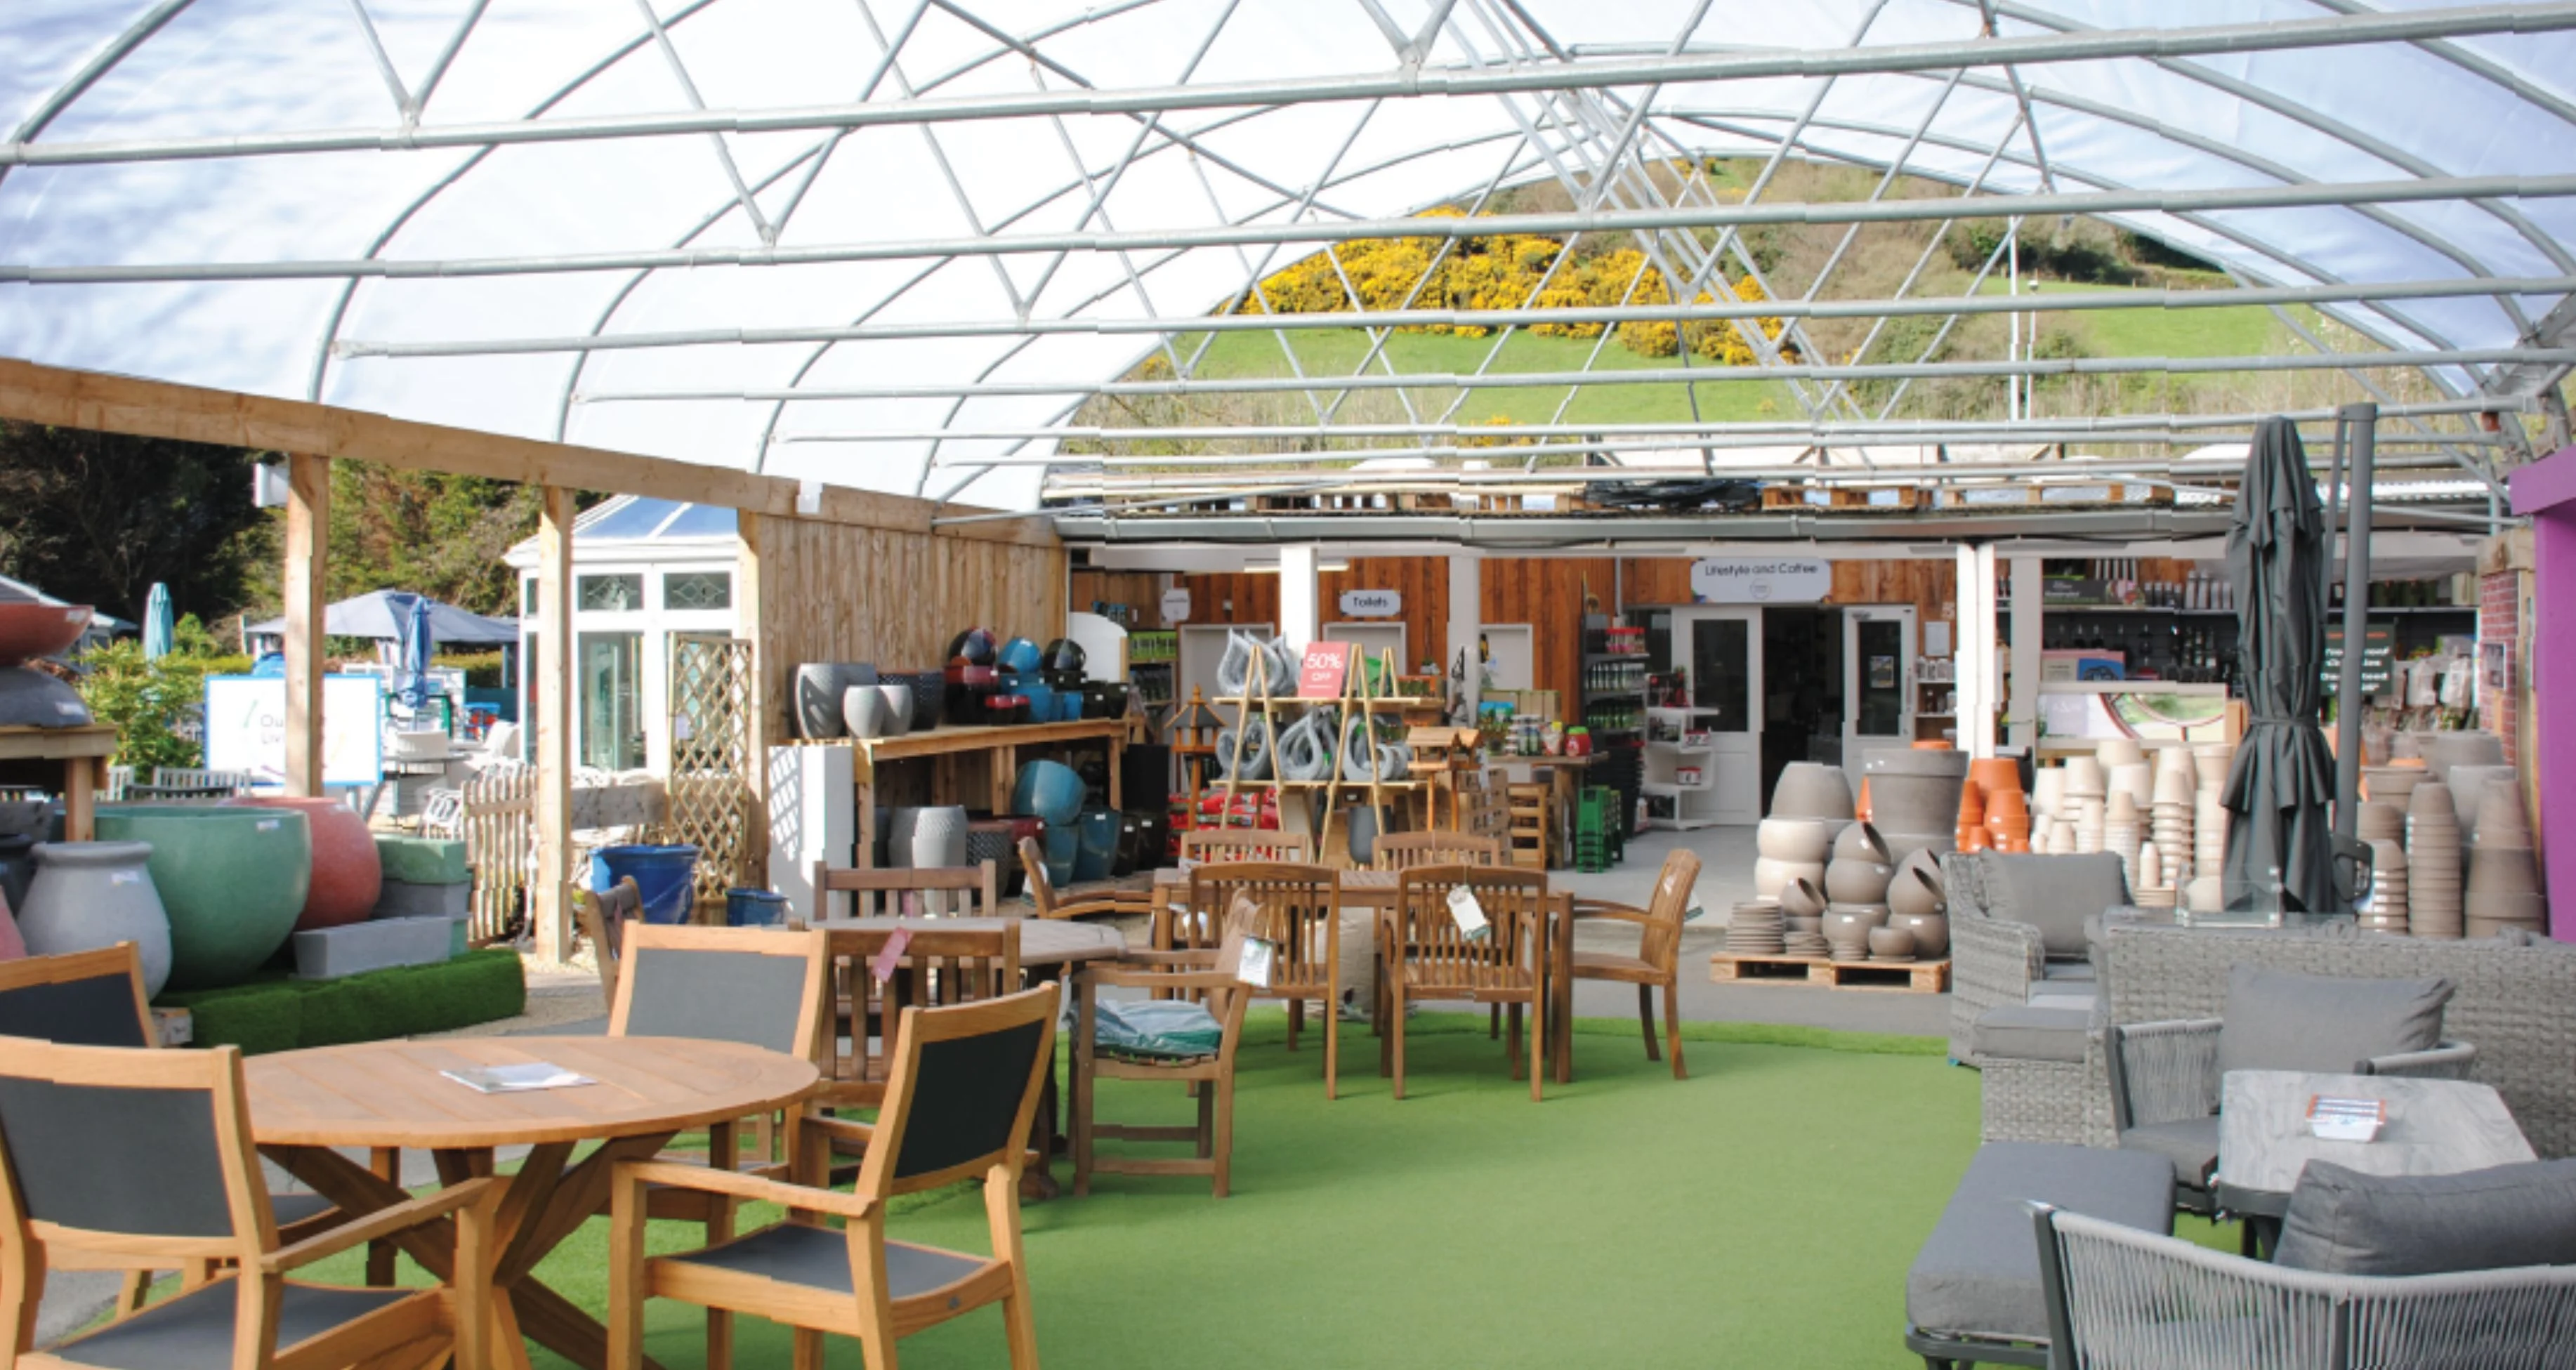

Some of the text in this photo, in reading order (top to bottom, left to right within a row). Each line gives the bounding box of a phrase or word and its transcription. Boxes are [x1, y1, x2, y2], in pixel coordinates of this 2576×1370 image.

[1705, 562, 1818, 578] Lifestyle and Coffee
[1353, 596, 1389, 608] Toilets
[1306, 652, 1343, 669] 50%
[1311, 672, 1332, 682] OFF
